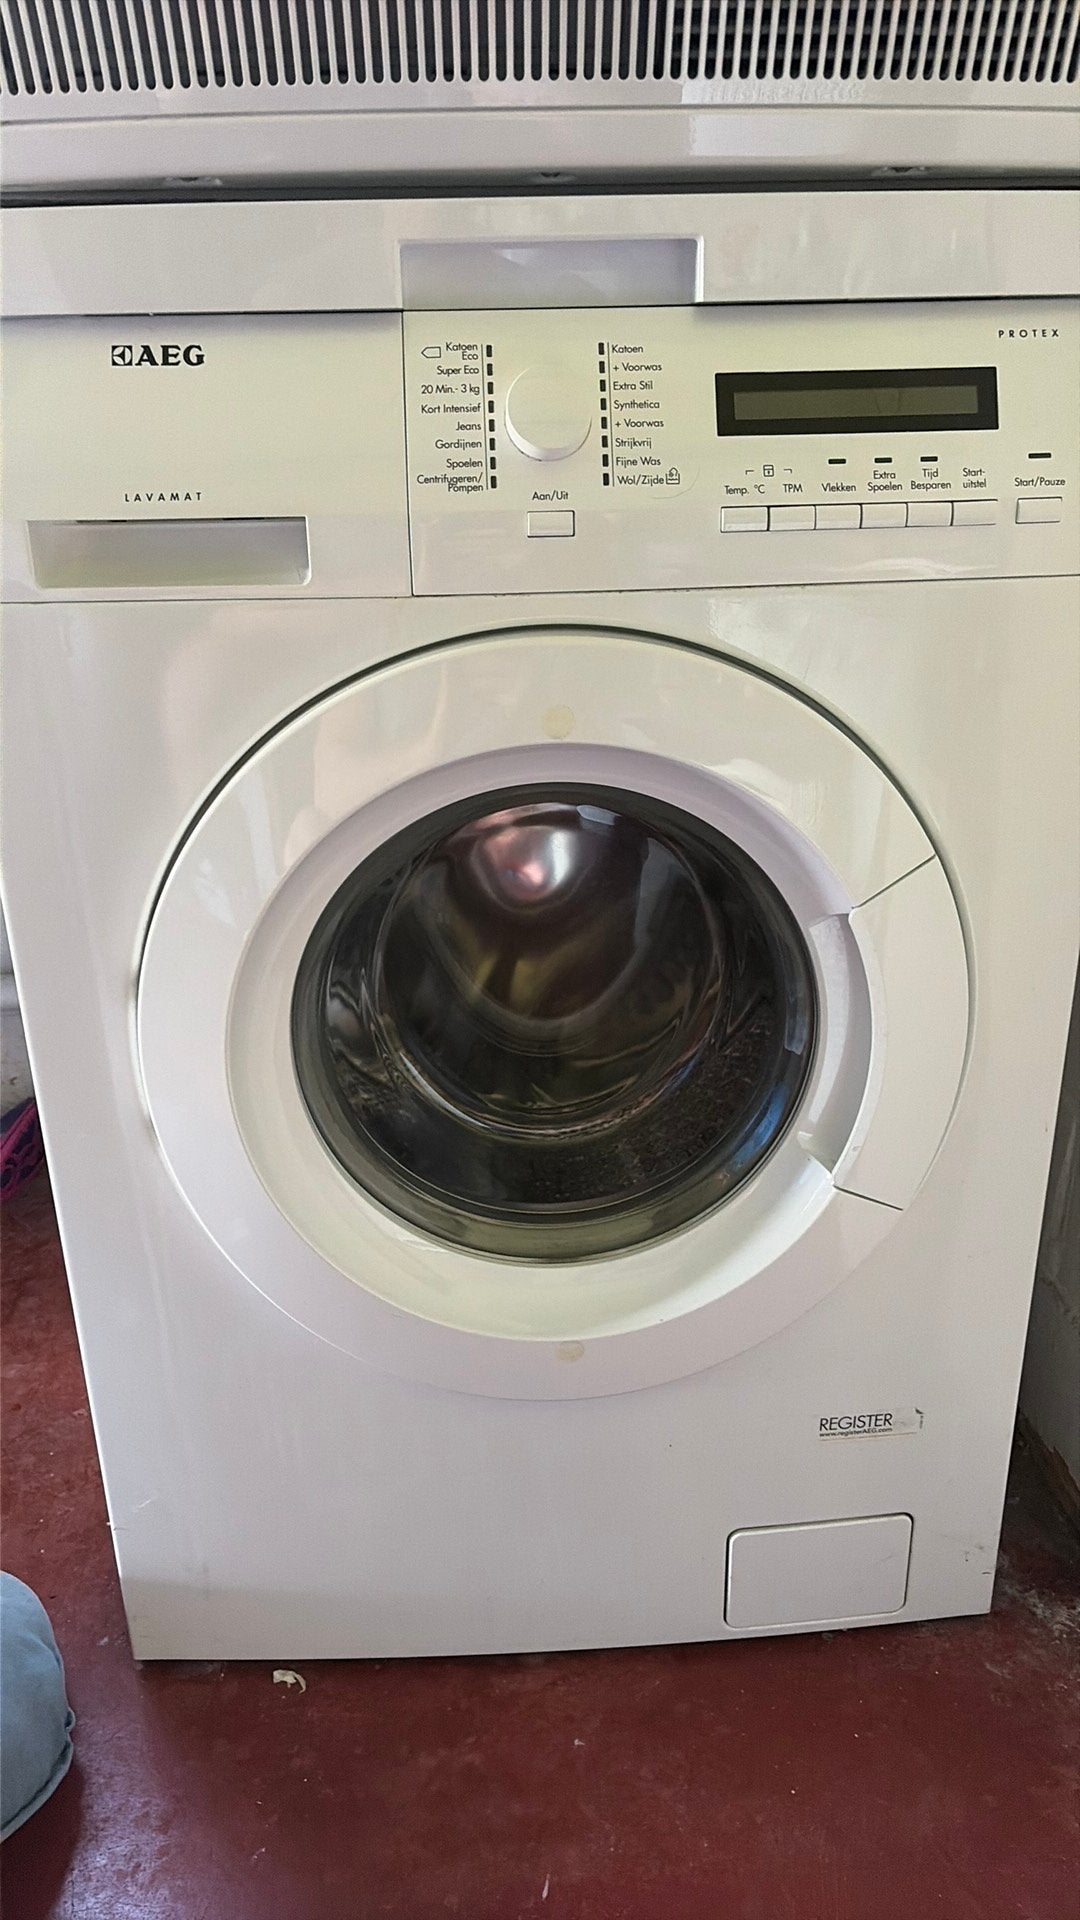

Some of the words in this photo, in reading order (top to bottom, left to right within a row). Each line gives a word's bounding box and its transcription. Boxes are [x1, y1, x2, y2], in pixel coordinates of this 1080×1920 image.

[998, 328, 1059, 339] PROTEX
[445, 342, 478, 352] Katoen
[611, 344, 644, 354] Katoen
[135, 344, 205, 366] AEG
[462, 351, 479, 361] Eco
[436, 365, 462, 377] Super
[463, 364, 480, 375] Eco
[622, 362, 663, 372] Voorwas
[421, 384, 434, 395] 20
[460, 383, 467, 394] 3
[469, 383, 480, 396] kg
[613, 381, 637, 391] Extra
[639, 380, 653, 390] Stil
[421, 404, 441, 414] Kort
[443, 402, 481, 414] Intensief
[613, 399, 660, 412] Synthetica
[455, 421, 482, 431] Jeans
[623, 418, 664, 428] Voorwas
[435, 438, 482, 451] Gordijnen
[615, 437, 652, 449] Strijkvrij
[446, 458, 483, 470] Spoelen
[615, 456, 638, 469] Fijne
[640, 456, 662, 466] Was
[873, 470, 896, 479] Extra
[922, 468, 939, 478] Tijd
[962, 467, 986, 477] Start-
[416, 471, 483, 485] Centrifugeren/
[616, 474, 664, 487] Wol/Zijde
[1014, 477, 1066, 488] Start/Pauze
[448, 483, 484, 494] Pompen
[782, 483, 803, 493] TPM
[821, 482, 857, 493] Vlekken
[867, 482, 903, 493] Spoelen
[911, 480, 952, 492] Besparen
[963, 479, 987, 489] uitstel
[531, 490, 569, 501] Aan/Uit
[724, 485, 750, 496] Temp.
[124, 492, 201, 503] LAVAMAT
[819, 1413, 893, 1432] REGISTER
